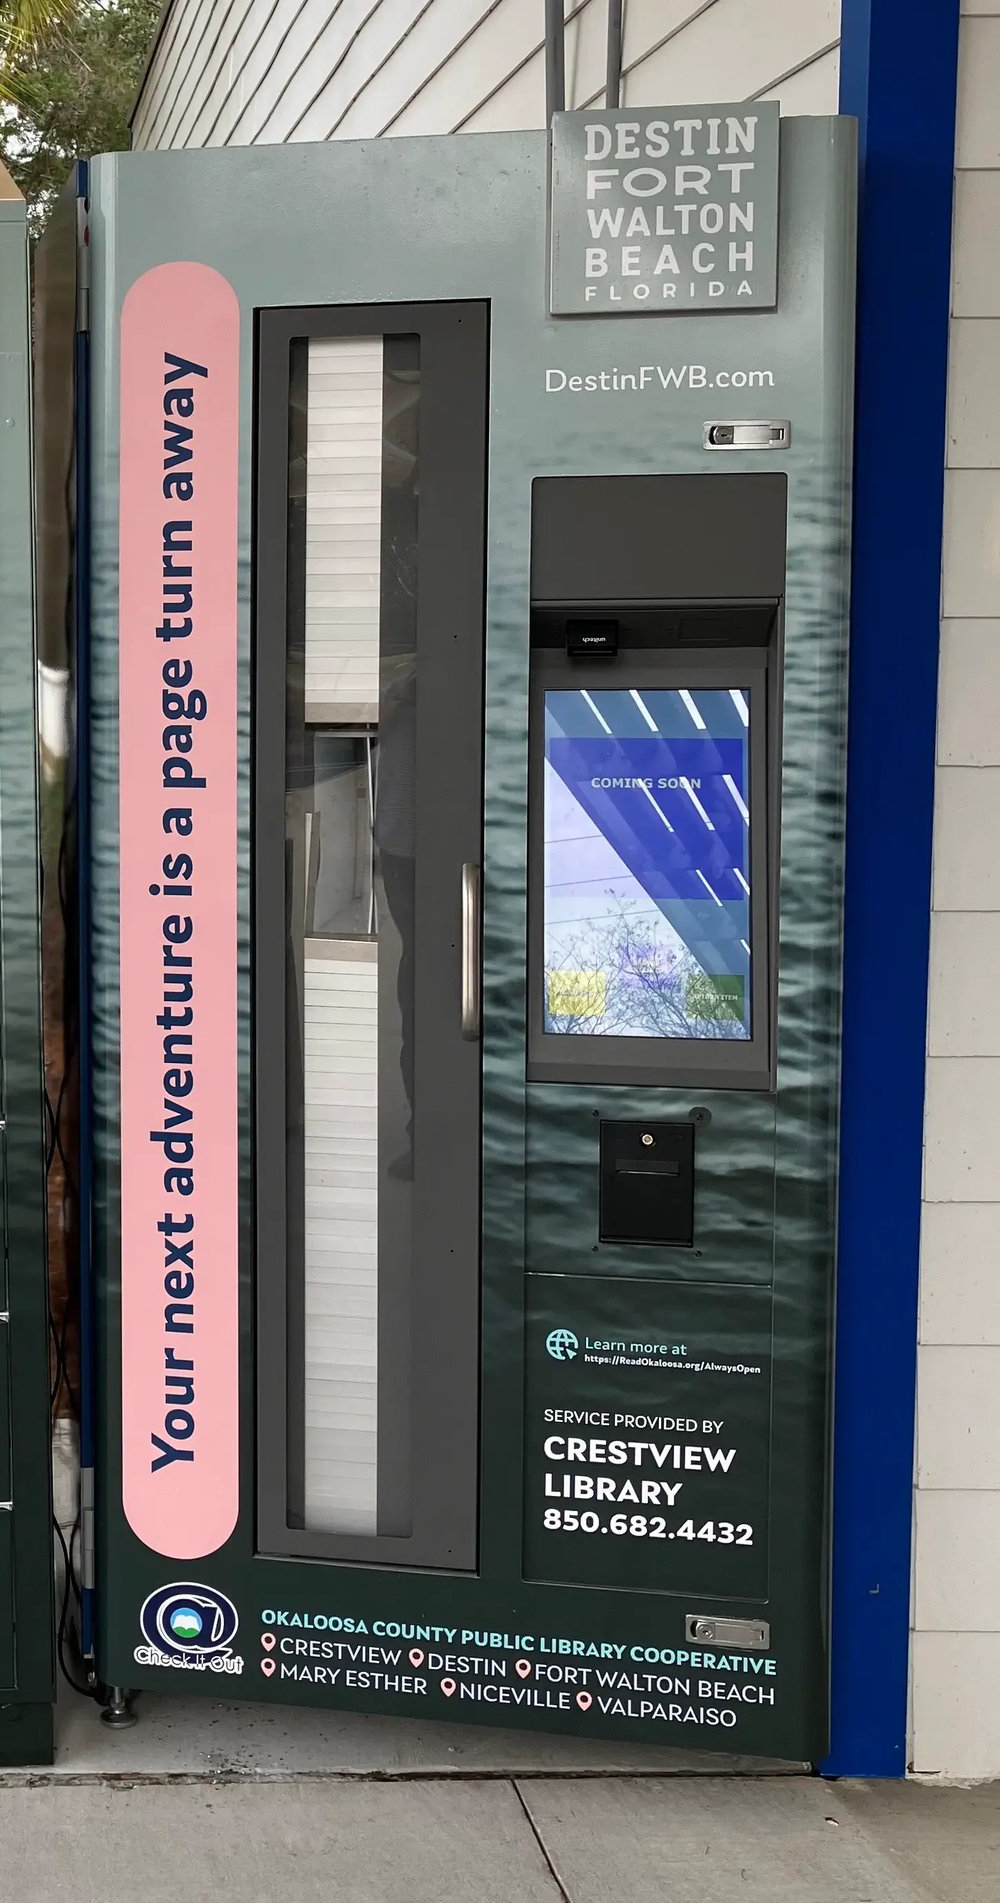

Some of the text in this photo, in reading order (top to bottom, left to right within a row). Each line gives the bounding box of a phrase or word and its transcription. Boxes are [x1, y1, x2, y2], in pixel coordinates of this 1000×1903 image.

[585, 116, 758, 160] DESTIN
[586, 162, 754, 200] FORT
[587, 202, 754, 238] WALTON
[585, 241, 753, 278] BEACH
[585, 280, 752, 301] FLORIDA
[545, 365, 775, 392] DestinFWB.com
[591, 777, 653, 788] COMING
[148, 351, 208, 1473] Your next adventure is a page turn away
[584, 1354, 761, 1374] https://ReadOkaloosa.org/AlwaysOpen
[585, 1337, 687, 1356] Learn more at
[544, 1409, 724, 1434] SERVICE PROVIDED BY
[544, 1436, 736, 1473] CRESTVIEW
[544, 1473, 683, 1506] LIBRARY
[543, 1509, 753, 1545] 850.682.4432
[261, 1609, 777, 1675] OKALOOSA COUNTY PUBLIC LIBRARY COOPERATIVE
[136, 1648, 243, 1673] Check It Out
[280, 1637, 775, 1705] CRESTVIEW DESTIN FORT WALTON BEACH
[280, 1663, 737, 1727] MARY ESTHER NICEVILLE VALPARAISO
